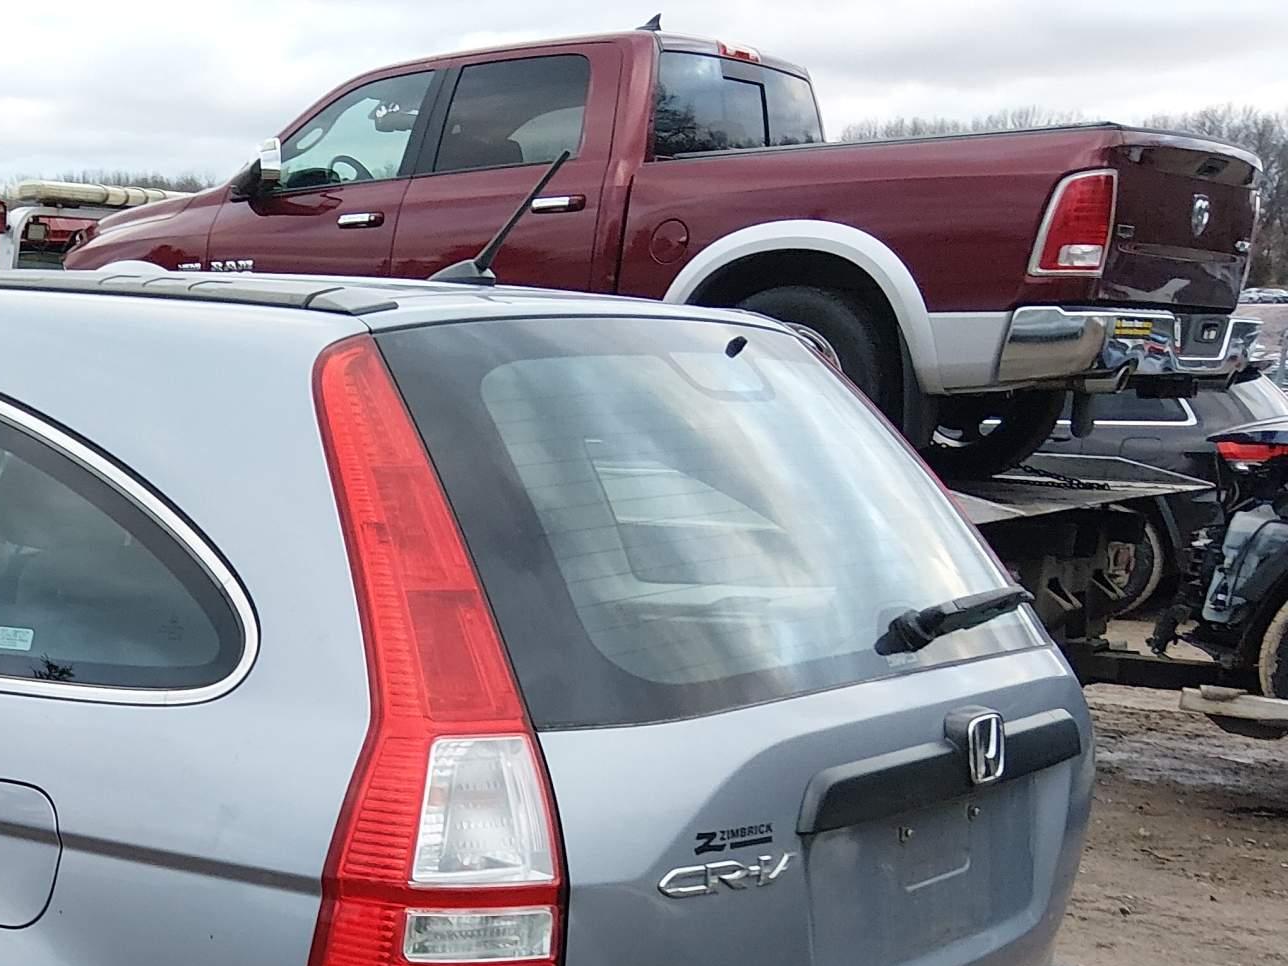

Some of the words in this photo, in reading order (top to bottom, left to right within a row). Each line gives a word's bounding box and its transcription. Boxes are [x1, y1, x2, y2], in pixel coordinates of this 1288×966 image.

[210, 260, 254, 272] RAM
[719, 823, 773, 841] ZIMBRICK
[657, 852, 798, 899] CR-V
